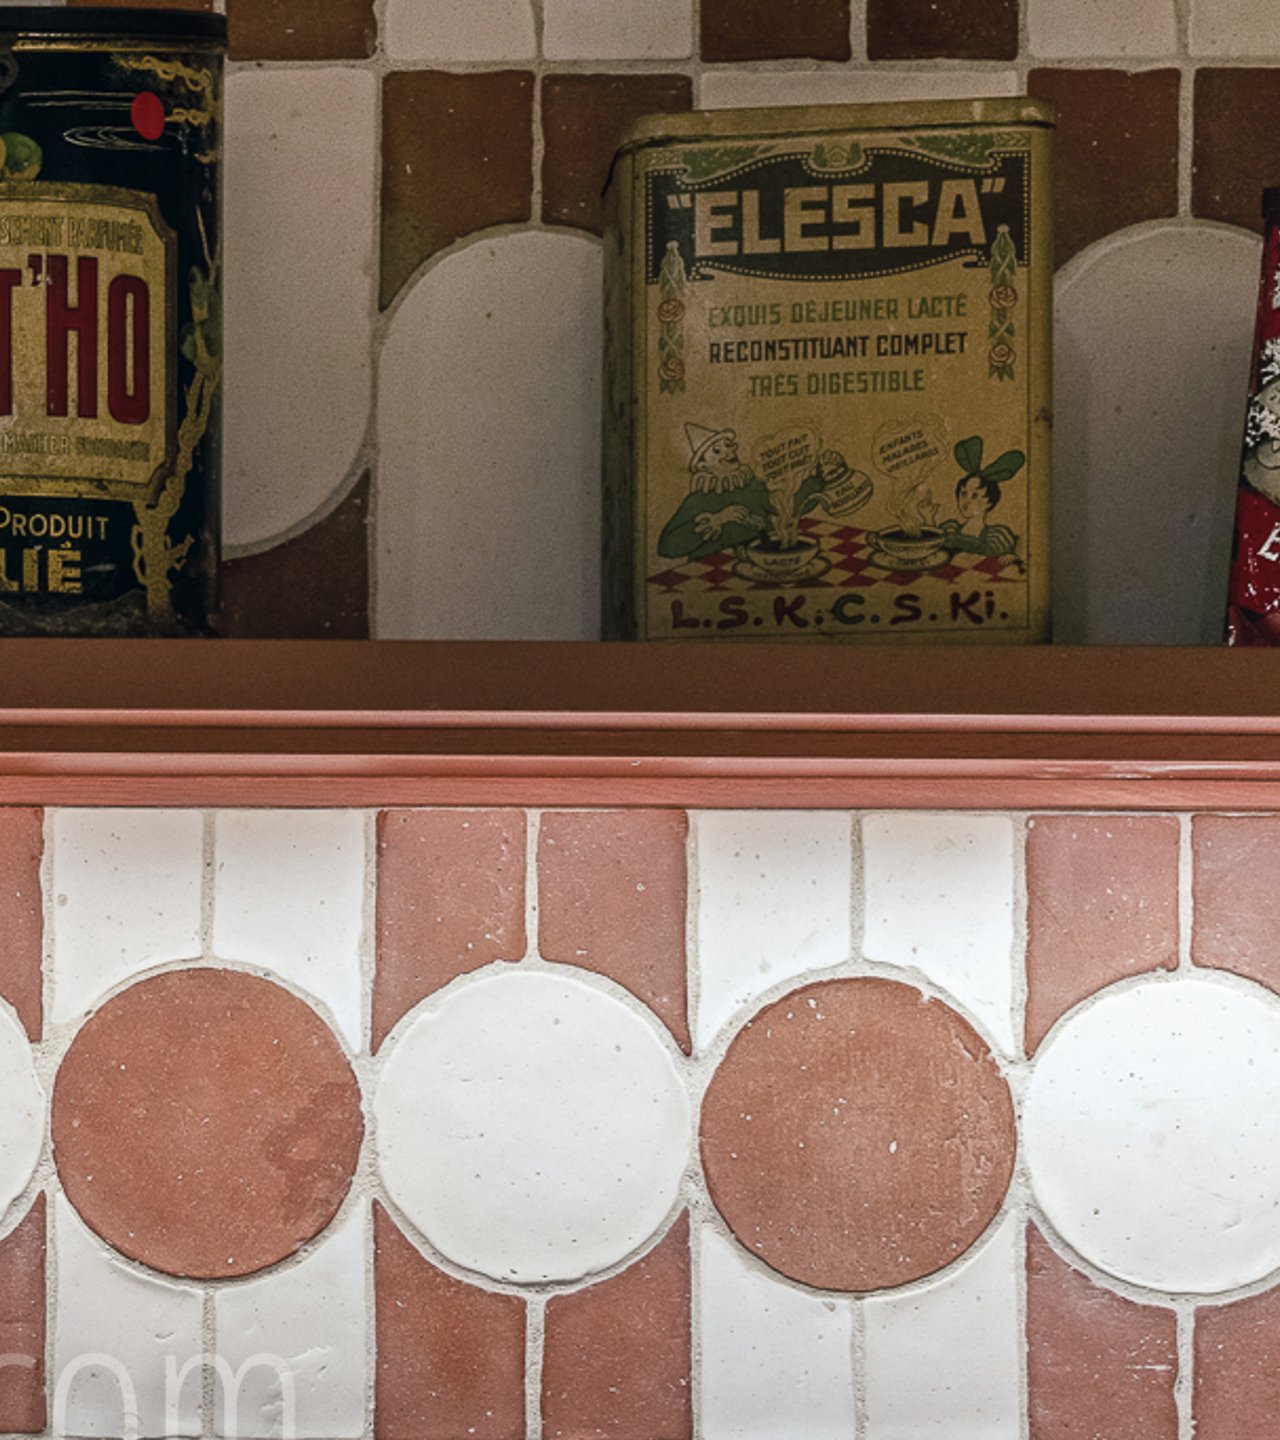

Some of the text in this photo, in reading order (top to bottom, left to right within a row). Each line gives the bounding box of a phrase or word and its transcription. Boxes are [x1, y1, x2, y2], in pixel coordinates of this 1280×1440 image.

[708, 292, 967, 327] EXQUIS DÉJEUNER LACTÉ
[709, 332, 968, 363] RECONSTITUANT COMPLET
[806, 369, 925, 395] DIGESTIBLE
